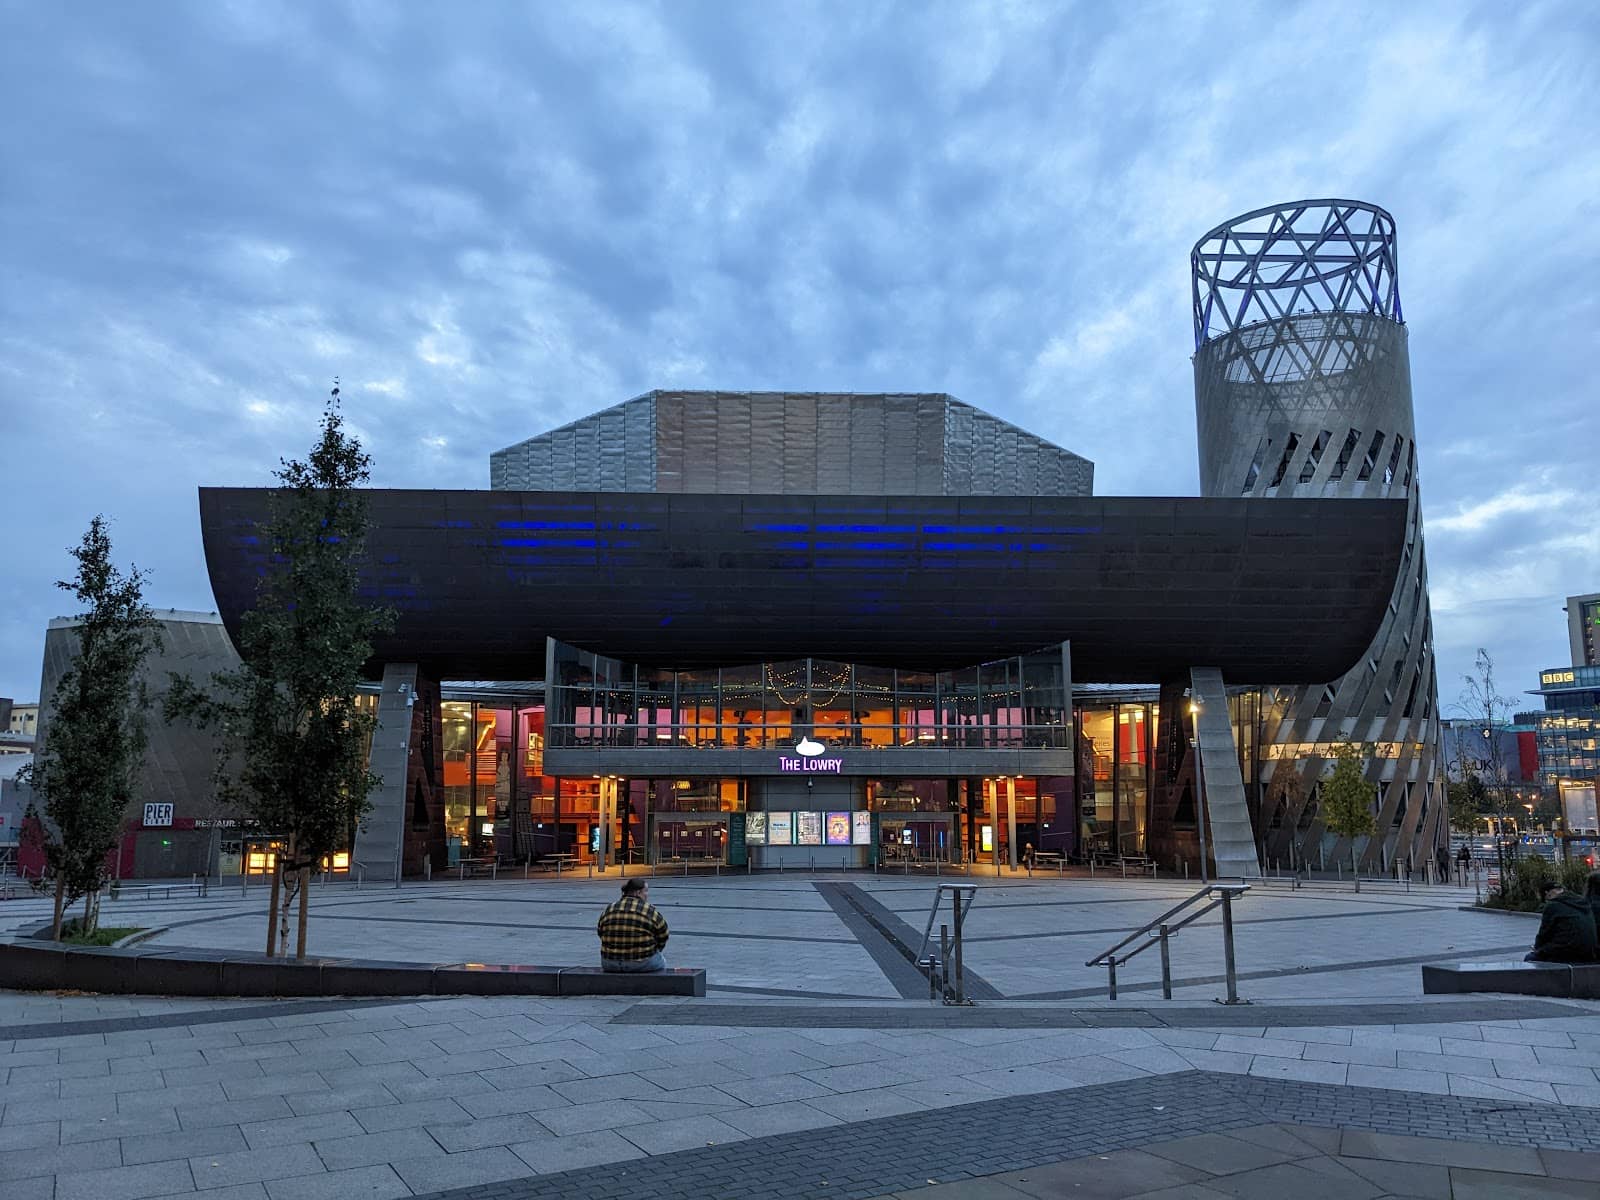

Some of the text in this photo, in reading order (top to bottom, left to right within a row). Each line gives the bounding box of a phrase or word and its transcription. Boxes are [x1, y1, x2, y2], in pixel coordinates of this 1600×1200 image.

[1543, 673, 1573, 683] BBC
[779, 757, 842, 774] THE LOWRY
[146, 804, 171, 819] PIER
